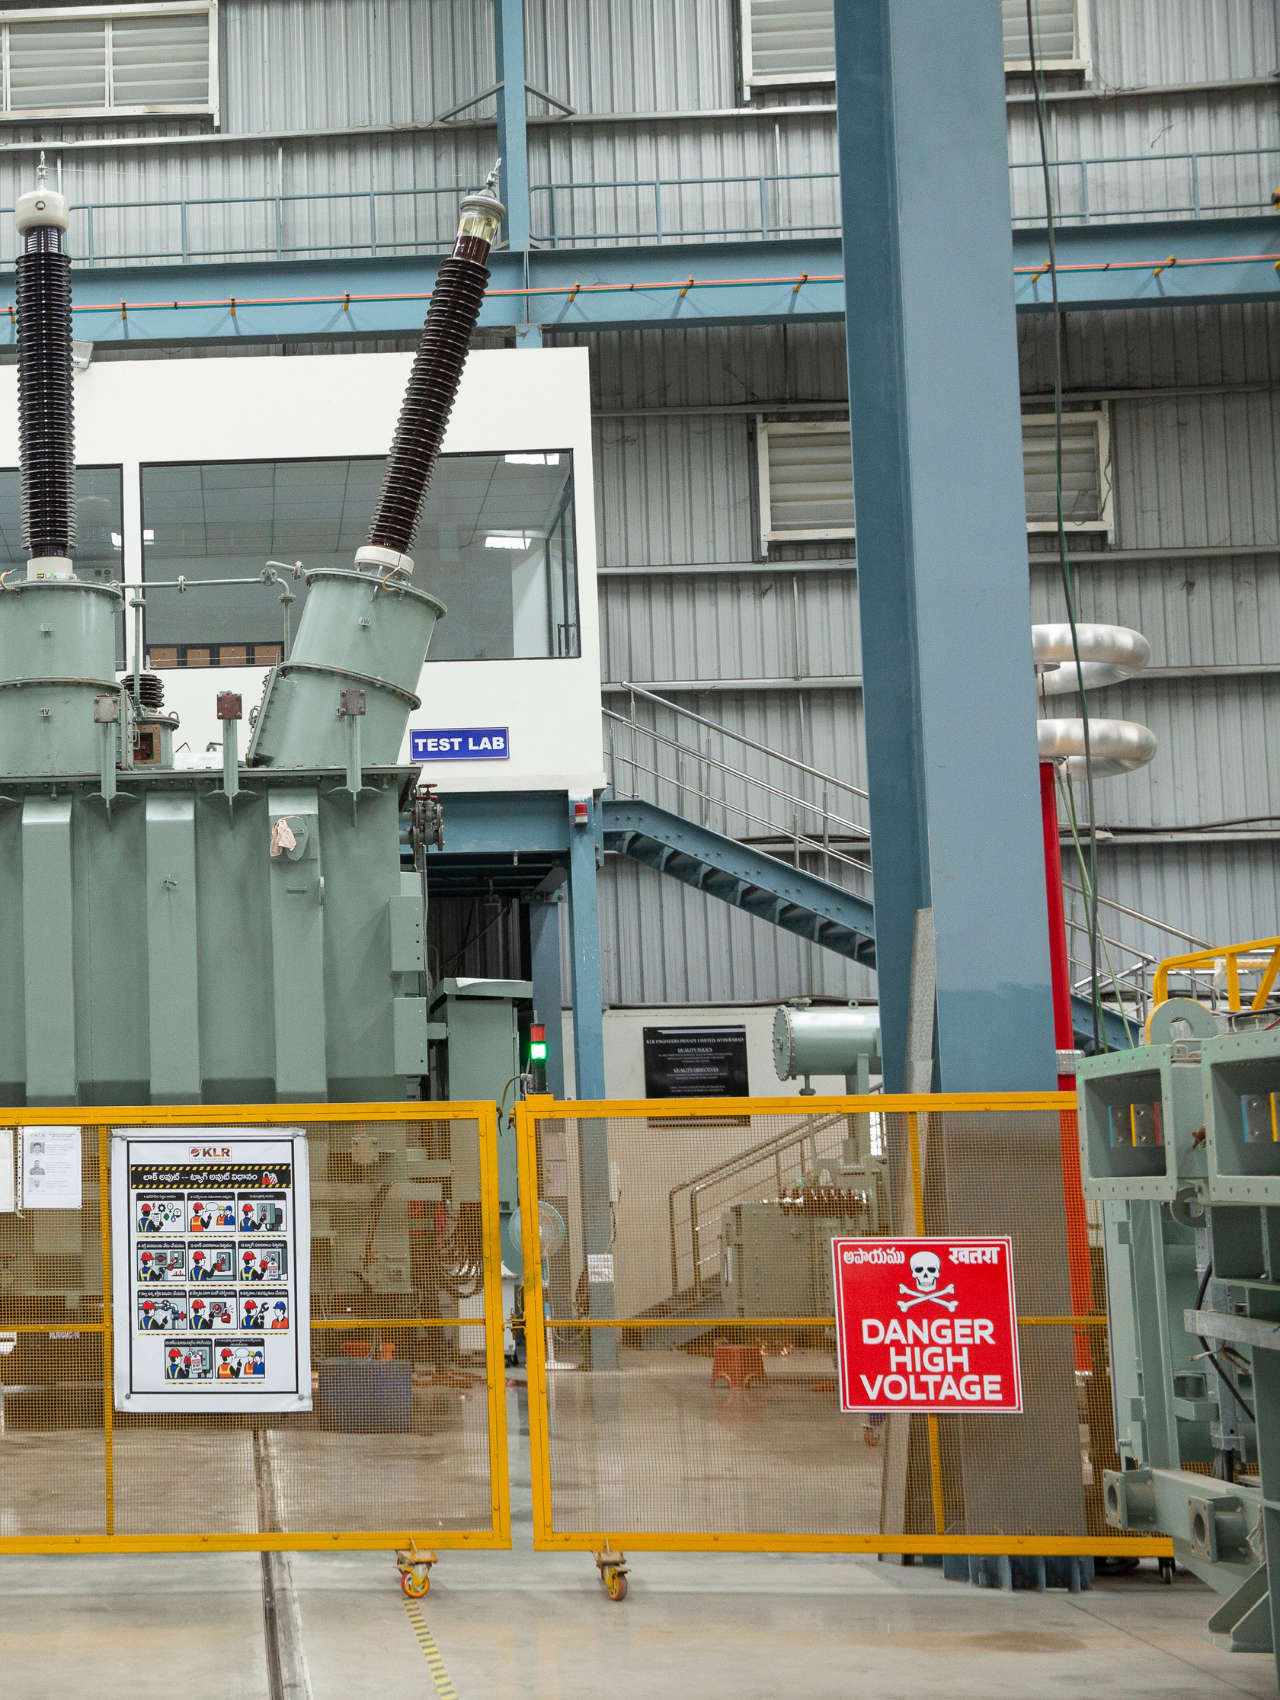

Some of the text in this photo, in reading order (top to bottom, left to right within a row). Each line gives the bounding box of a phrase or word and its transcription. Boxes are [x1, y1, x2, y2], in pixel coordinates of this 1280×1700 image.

[414, 737, 505, 752] TEST LAB
[202, 1148, 230, 1157] KLR
[844, 1247, 905, 1264] అపాయము
[949, 1247, 1000, 1265] खतरा
[861, 1318, 995, 1345] DANGER
[889, 1346, 969, 1372] HIGH
[860, 1374, 1003, 1400] VOLTAGE
